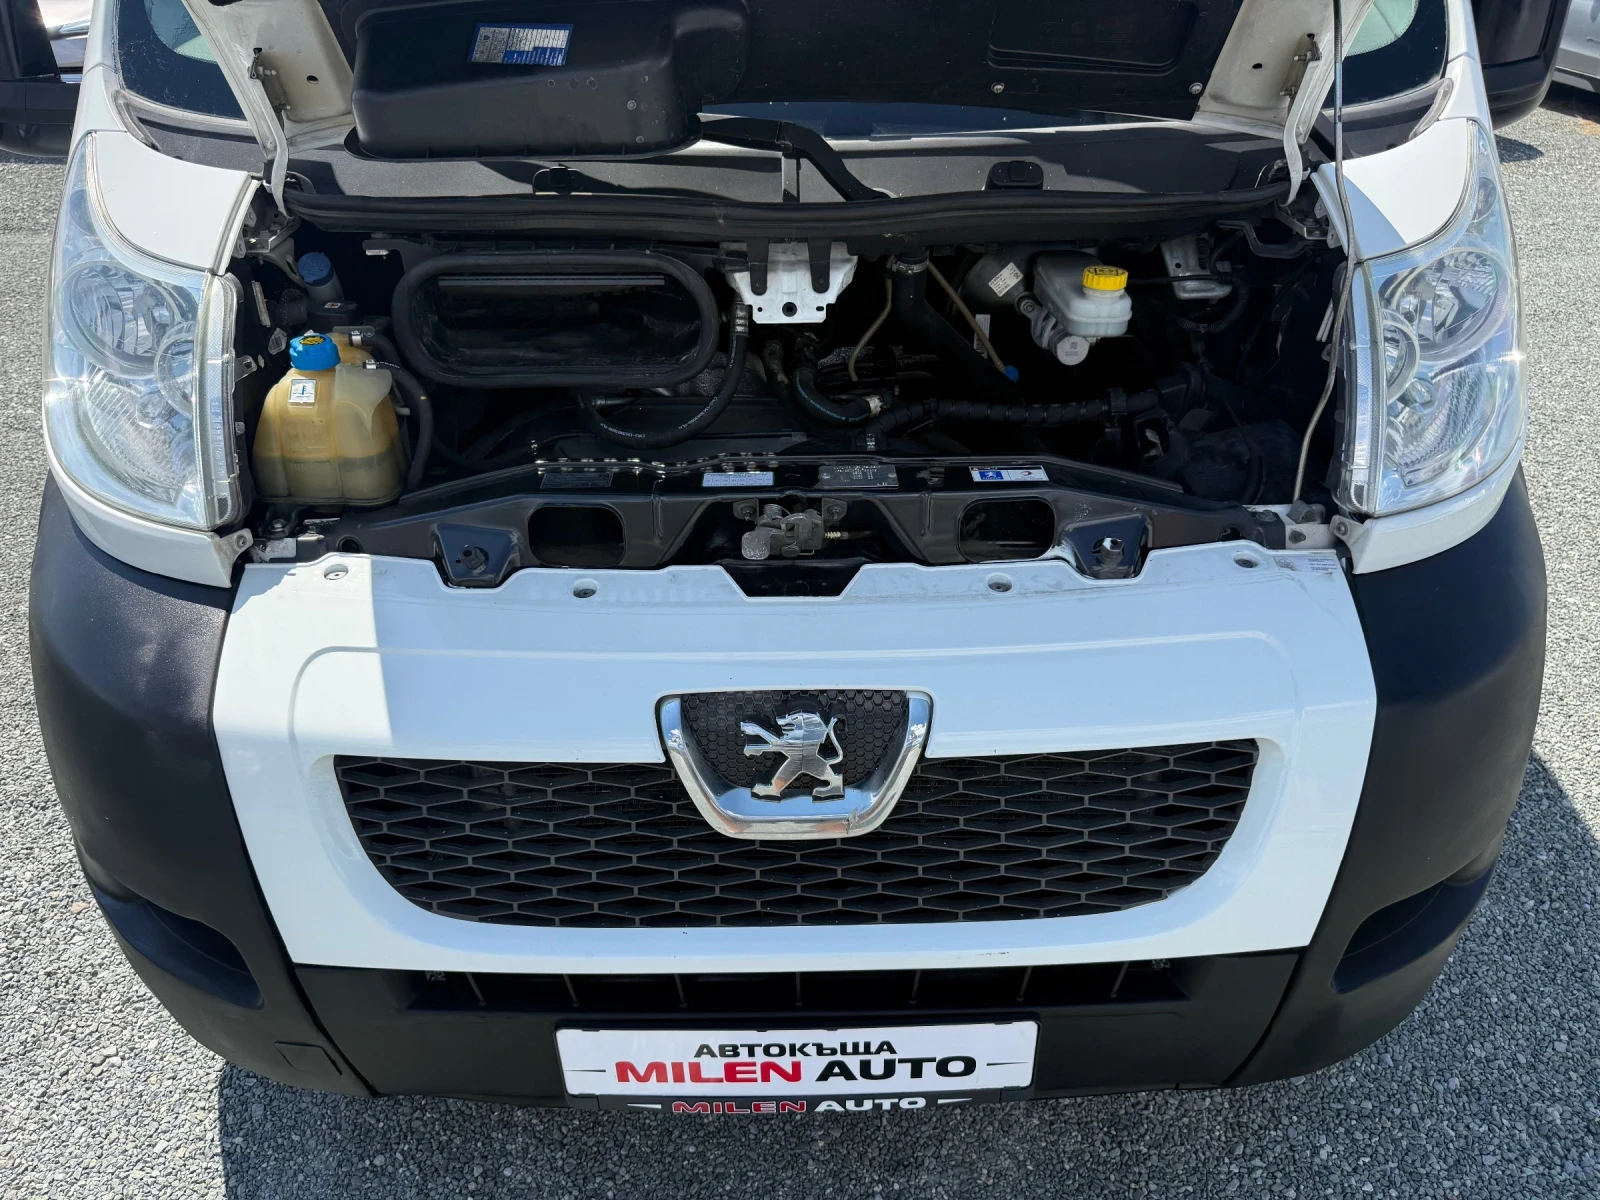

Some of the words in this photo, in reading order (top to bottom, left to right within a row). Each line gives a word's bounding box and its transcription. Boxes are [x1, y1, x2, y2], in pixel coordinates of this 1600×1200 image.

[693, 1040, 898, 1058] АВТОКЪЩА
[614, 1060, 802, 1083] MILEN
[815, 1055, 977, 1082] AUTO
[671, 1100, 807, 1114] MILEN
[813, 1097, 927, 1113] AUTO
